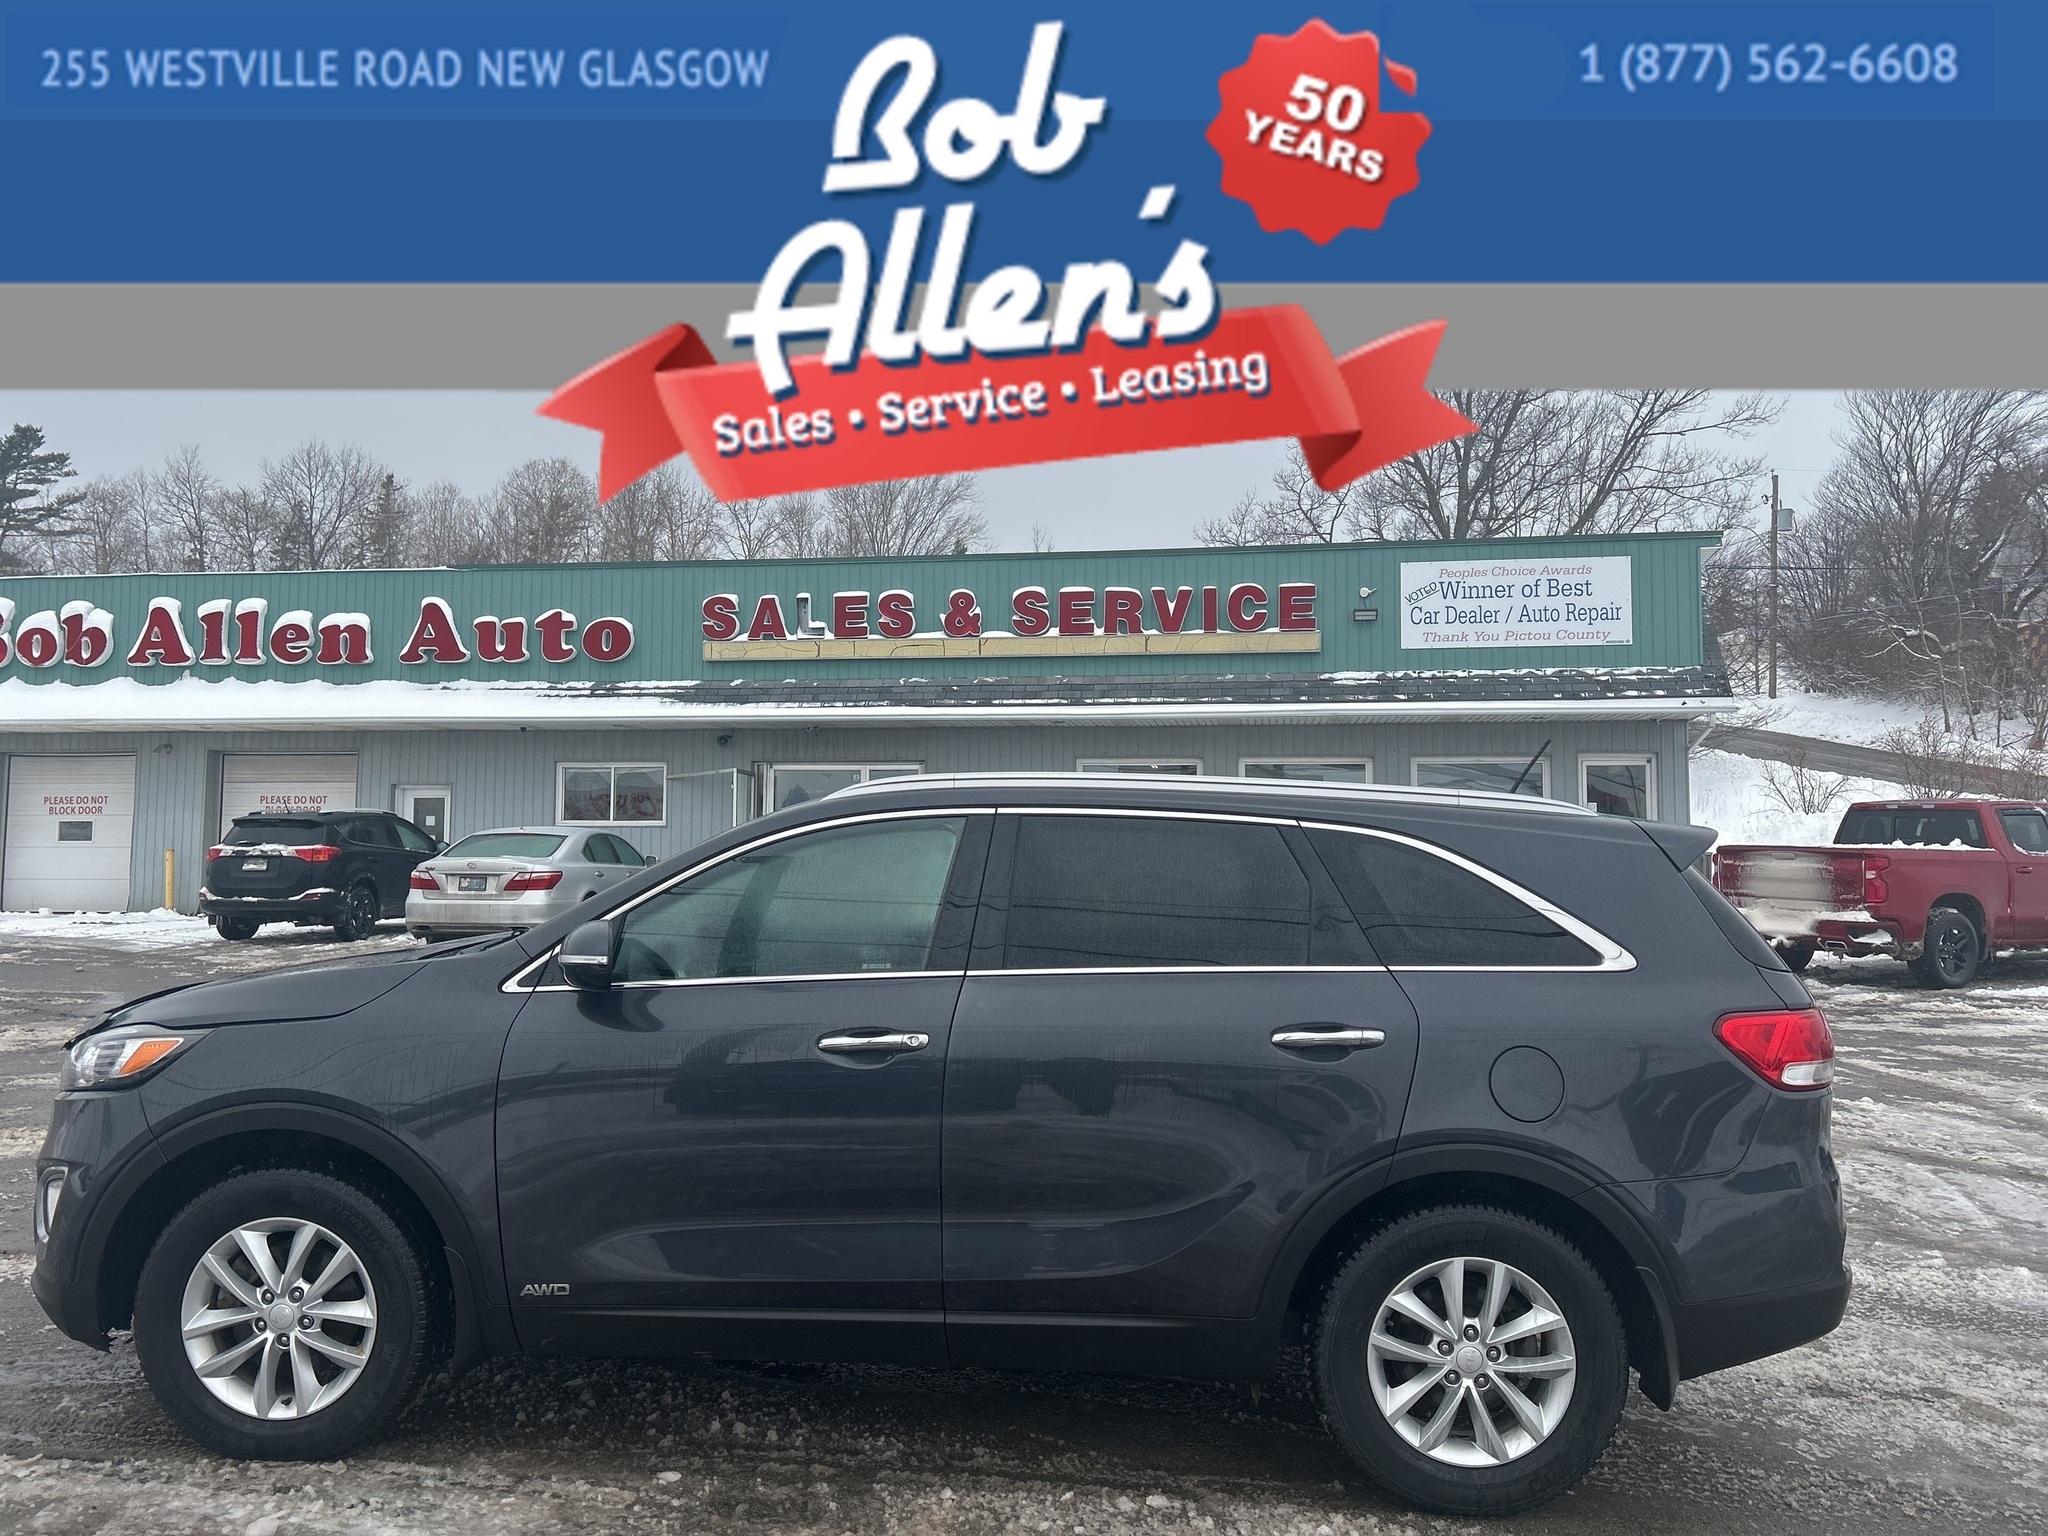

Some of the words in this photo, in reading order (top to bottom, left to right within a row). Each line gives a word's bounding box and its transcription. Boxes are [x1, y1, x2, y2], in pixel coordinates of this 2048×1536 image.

[1439, 567, 1488, 580] Peoples
[1491, 565, 1537, 577] Choice
[1539, 564, 1593, 576] Awards
[1404, 581, 1438, 604] VOTED
[1438, 580, 1515, 600] Winner
[1521, 578, 1542, 598] of
[1546, 578, 1593, 598] Best
[702, 593, 917, 641] SALES
[943, 590, 982, 638] &
[1011, 584, 1318, 637] SERVICE
[1410, 606, 1441, 625] Car
[1444, 605, 1501, 625] Dealer
[1517, 604, 1560, 623] Auto
[1565, 601, 1623, 626] Repair
[127, 600, 372, 666] Allen
[400, 599, 635, 664] Auto
[1422, 631, 1469, 643] Thank
[1474, 631, 1500, 642] You
[1504, 630, 1552, 642] Pictou
[1555, 629, 1612, 642] County
[43, 796, 75, 805] PLEASE
[76, 796, 89, 805] DO
[90, 795, 109, 804] NOT
[260, 795, 292, 804] PLEASE
[294, 795, 307, 804] DO
[309, 795, 328, 804] NOT
[48, 806, 76, 815] BLOCK
[78, 806, 103, 815] DOOR
[520, 1283, 570, 1296] AWD
